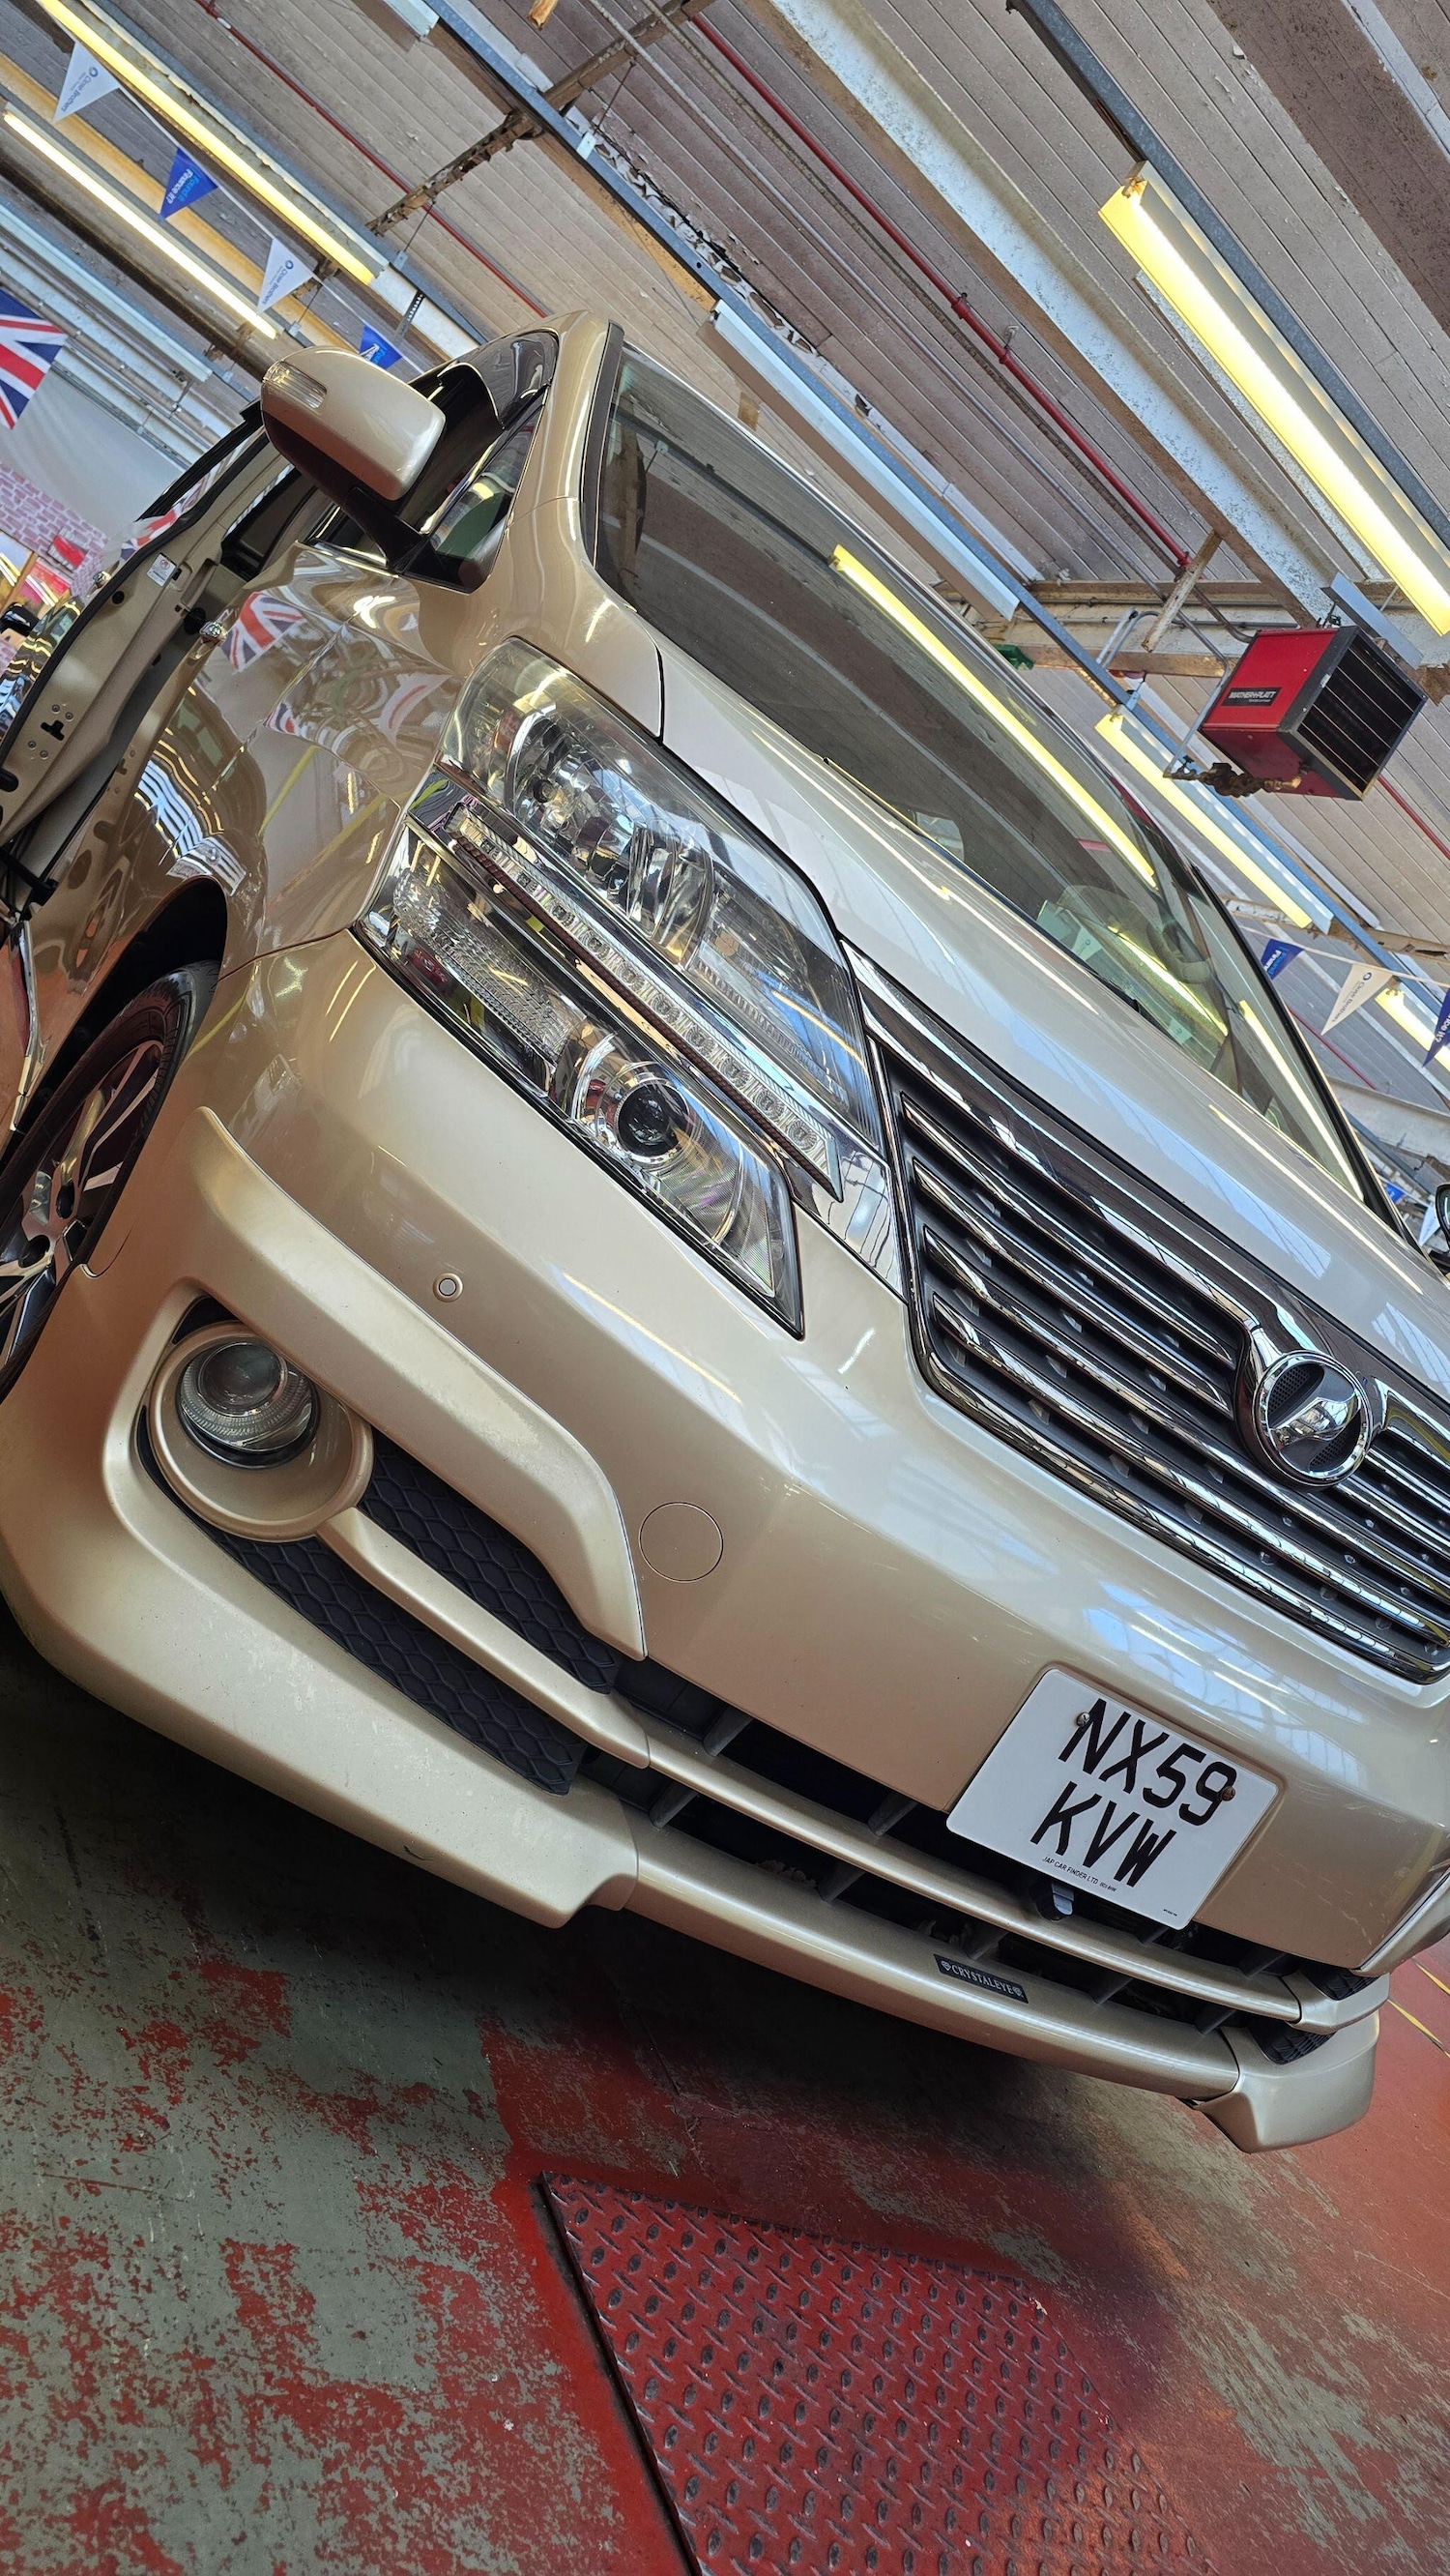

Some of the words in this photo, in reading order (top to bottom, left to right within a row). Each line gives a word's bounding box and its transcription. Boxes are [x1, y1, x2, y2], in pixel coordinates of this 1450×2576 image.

[78, 75, 92, 91] Close
[61, 90, 80, 112] Brothers
[171, 168, 194, 194] Finance
[276, 268, 288, 283] Close
[262, 282, 279, 305] Brothers
[1349, 981, 1365, 999] Close
[1331, 997, 1352, 1023] Brothers
[1058, 1698, 1237, 1827] NX59
[1030, 1780, 1177, 1888] KVW
[1054, 1860, 1067, 1871] CAR
[1066, 1866, 1088, 1880] FINDER
[1087, 1876, 1099, 1885] LTD
[951, 1964, 1014, 1995] CRYSTALEYE
